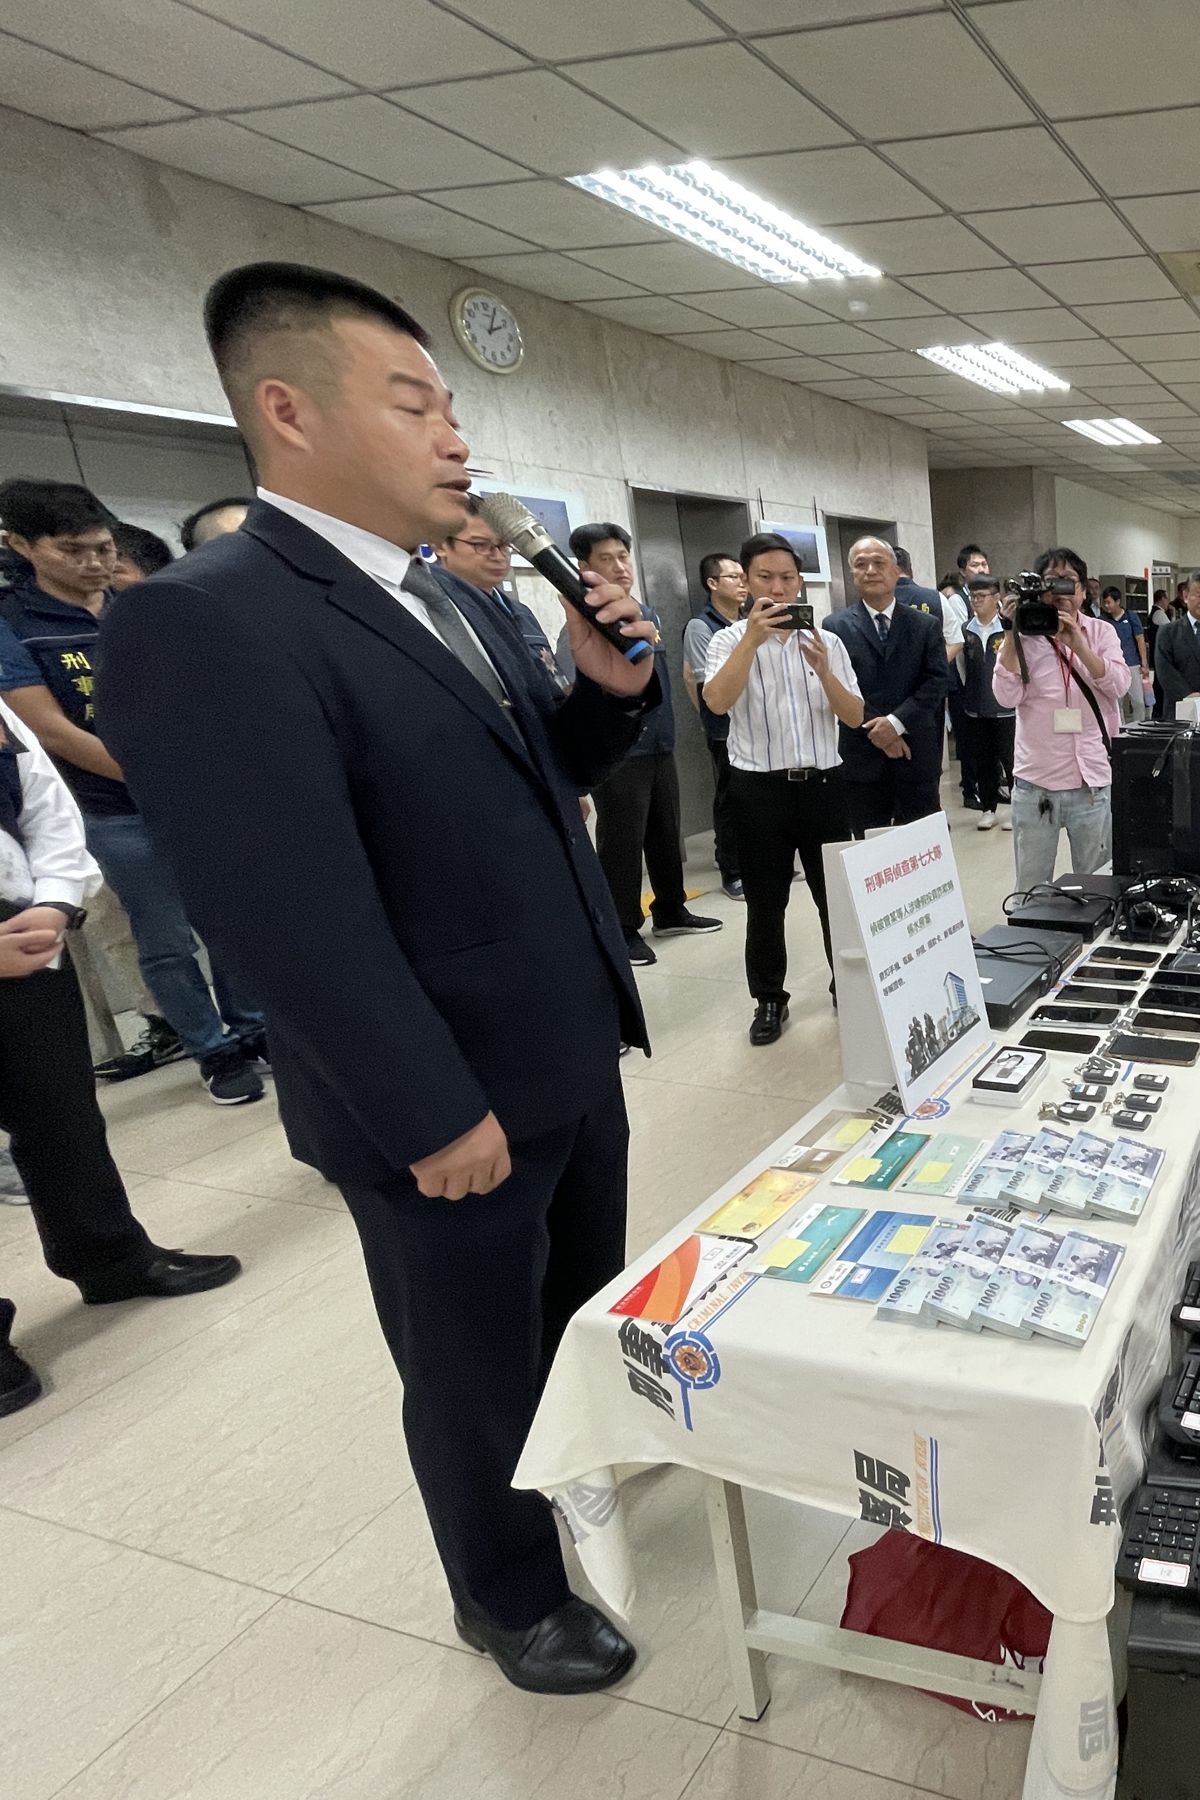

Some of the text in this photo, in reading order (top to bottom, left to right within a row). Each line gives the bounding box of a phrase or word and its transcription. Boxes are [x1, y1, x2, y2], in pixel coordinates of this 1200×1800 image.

[863, 844, 943, 894] 刑事局偵查第七大隊
[965, 1173, 985, 1193] 1000
[1006, 1170, 1026, 1191] 1000
[1047, 1174, 1065, 1195] 1000
[1091, 1181, 1109, 1201] 1000
[886, 1278, 911, 1303] 1000
[931, 1276, 955, 1301] 1000
[978, 1282, 1001, 1309] 1000
[1031, 1292, 1053, 1320] 1000
